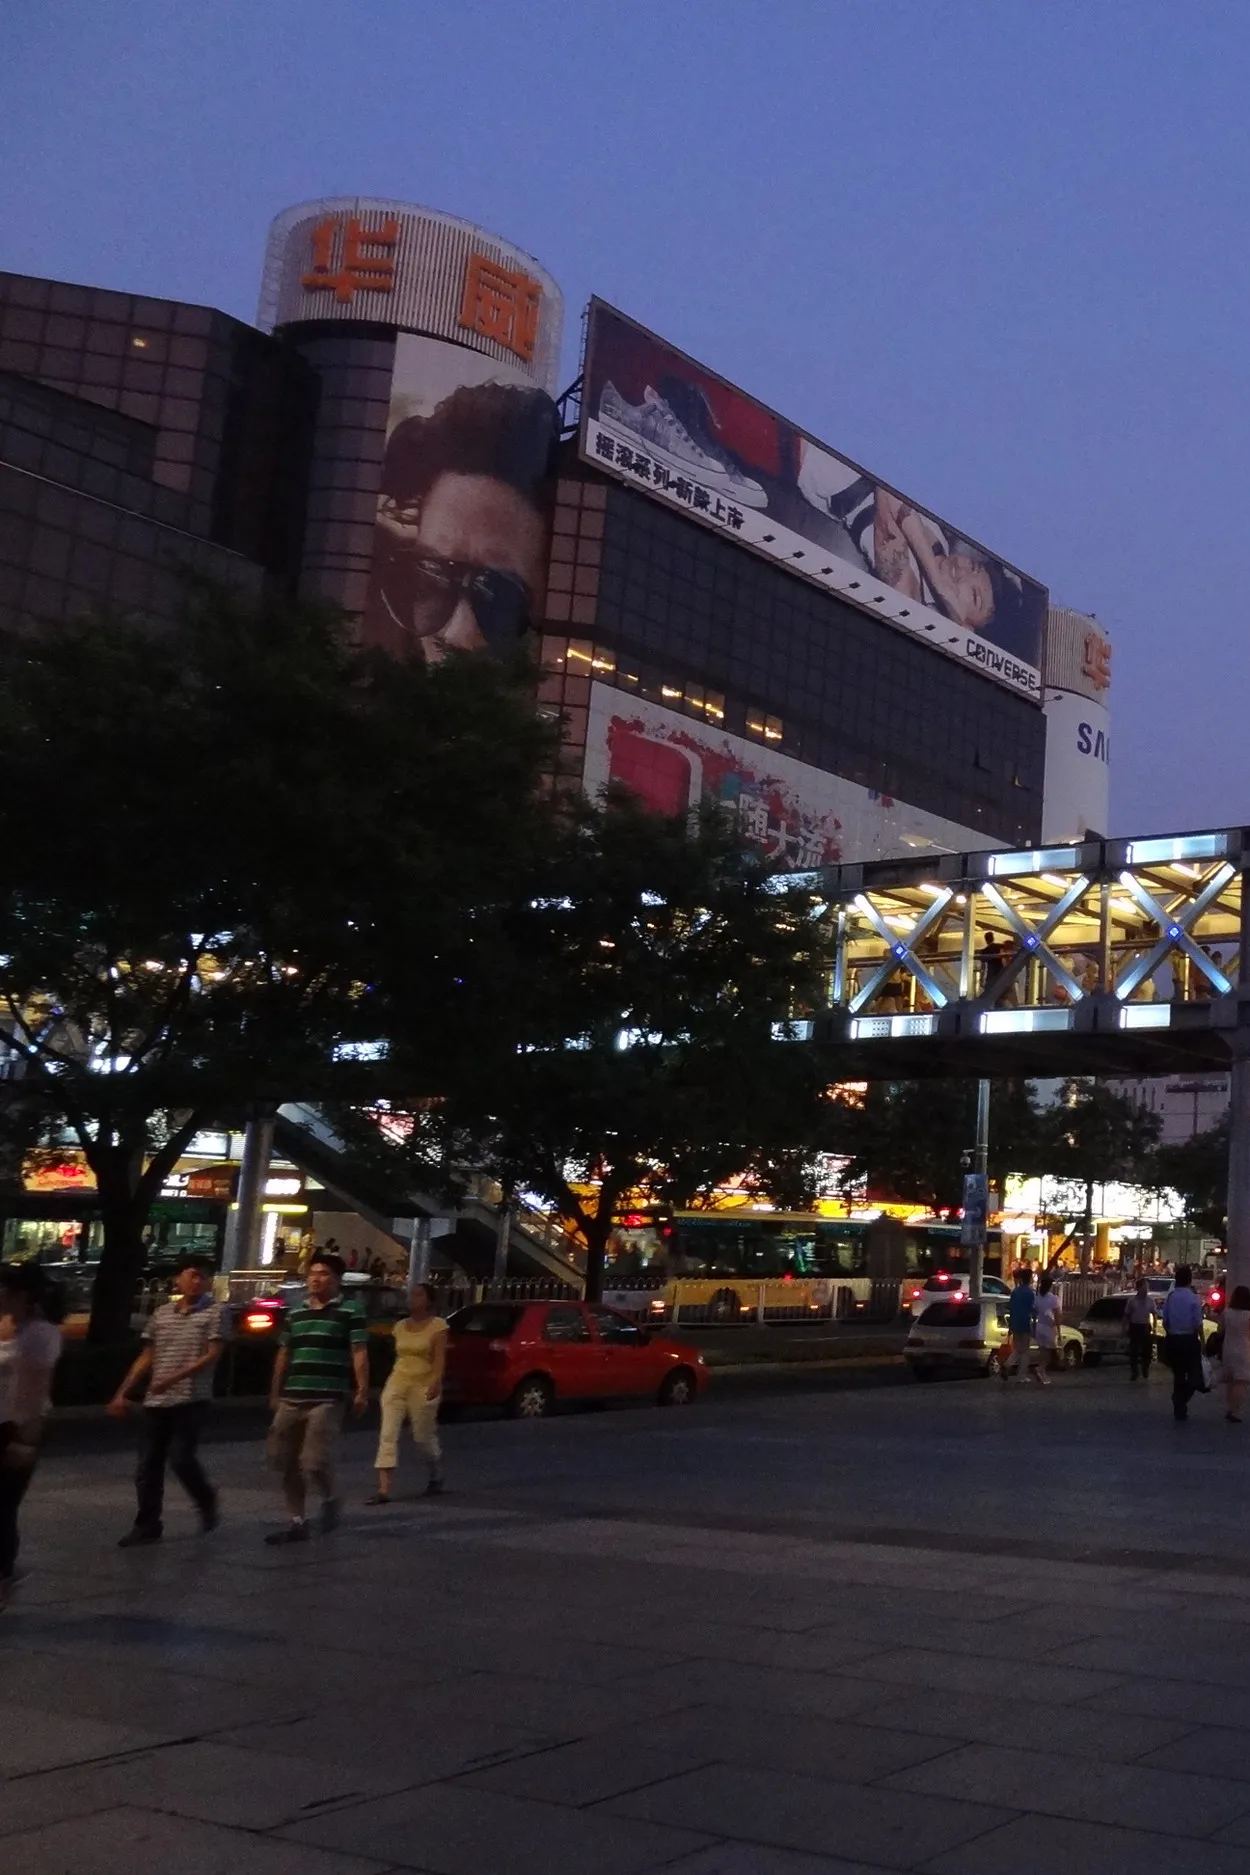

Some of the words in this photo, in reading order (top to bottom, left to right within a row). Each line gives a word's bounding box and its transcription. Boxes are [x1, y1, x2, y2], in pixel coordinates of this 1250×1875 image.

[301, 217, 542, 363] 华威
[966, 638, 1037, 691] CONVERSE
[1077, 722, 1110, 767] SA
